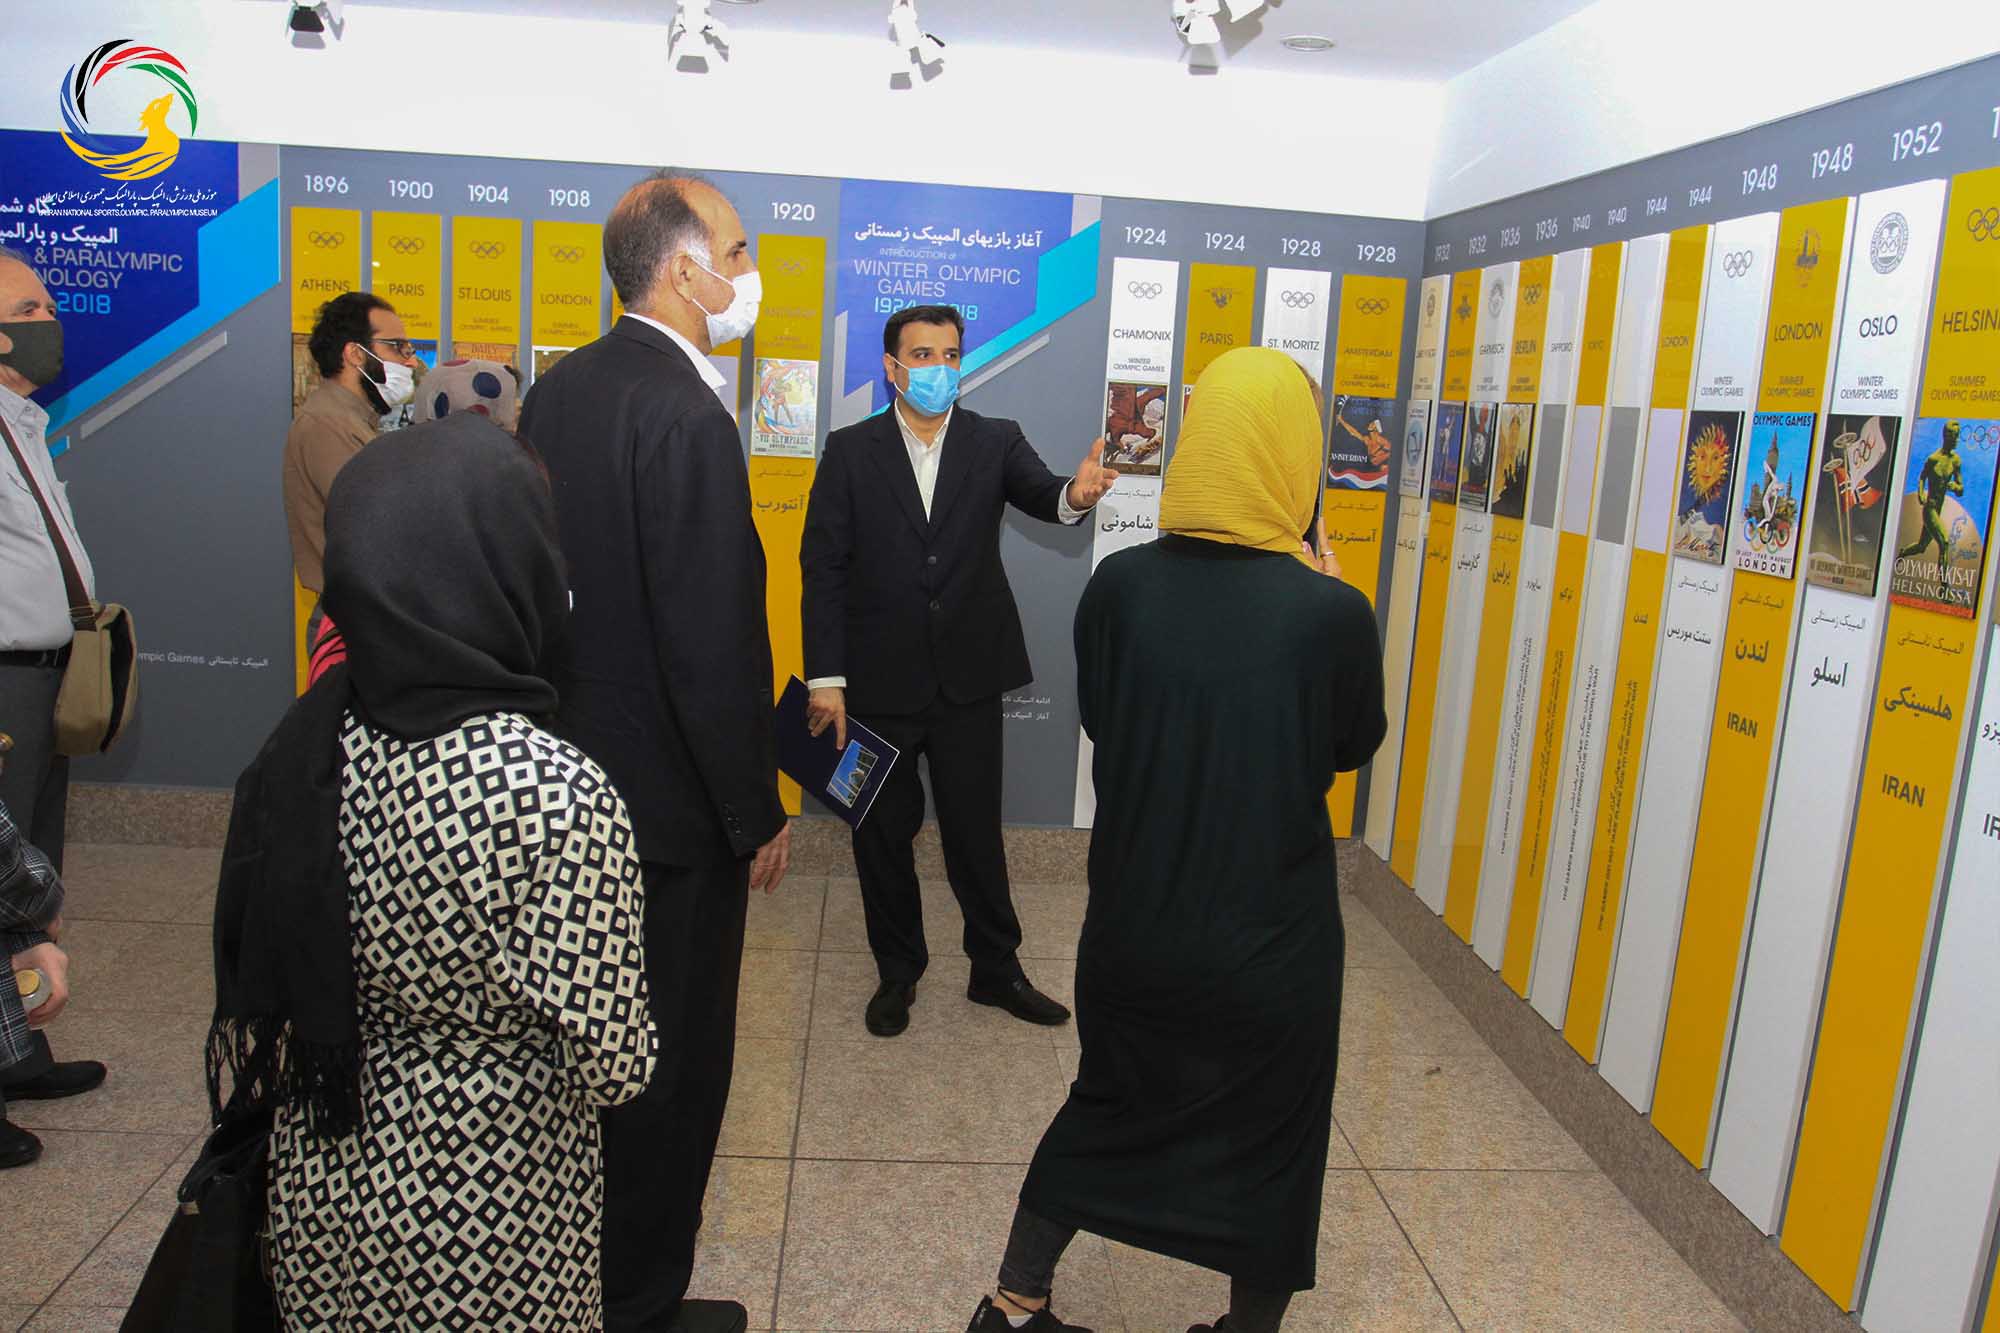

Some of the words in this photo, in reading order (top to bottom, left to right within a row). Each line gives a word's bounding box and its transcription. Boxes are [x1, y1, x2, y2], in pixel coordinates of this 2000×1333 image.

[1892, 121, 1942, 161] 1952
[1811, 143, 1854, 179] 1948
[304, 174, 350, 195] 1896
[388, 179, 434, 200] 1900
[1742, 164, 1778, 195] 1948
[467, 184, 510, 205] 1904
[548, 188, 591, 208] 1908
[1689, 185, 1713, 207] 1944
[771, 201, 816, 222] 1920
[1607, 206, 1628, 226] 1940
[1646, 196, 1668, 217] 1944
[854, 222, 909, 243] زمستانی
[1535, 218, 1558, 241] 1936
[1572, 214, 1591, 233] 1940
[50, 228, 59, 245] و
[61, 224, 118, 250] المپیک
[913, 226, 960, 247] المپیک
[962, 229, 1012, 248] بازیهای
[1014, 230, 1042, 248] آغاز
[1125, 226, 1168, 246] 1924
[1204, 232, 1246, 252] 1924
[1468, 235, 1487, 256] 1932
[1501, 226, 1521, 248] 1936
[879, 247, 947, 261] INTRODUCTION
[1281, 238, 1321, 257] 1928
[1356, 244, 1397, 263] 1928
[33, 247, 49, 265] &
[53, 247, 184, 273] PARALYMPIC
[854, 260, 929, 279] WINTER
[938, 264, 1022, 285] OLYMPIC
[299, 278, 351, 293] ATHENS
[388, 282, 425, 297] PARIS
[878, 279, 946, 298] GAMES
[56, 292, 112, 315] 2018
[539, 294, 592, 307] LONDON
[1859, 314, 1898, 338] OSLO
[1942, 307, 2000, 334] HELSIN
[1112, 328, 1171, 341] CHAMONIX
[1199, 332, 1234, 346] PARIS
[1773, 321, 1824, 343] LONDON
[1267, 338, 1281, 350] ST.
[1282, 339, 1320, 351] MORITZ
[1857, 375, 1884, 387] WINTER
[1949, 375, 1986, 387] SUMMER
[1840, 388, 1869, 400] OLYMPIC
[1870, 388, 1898, 400] GAMES
[1930, 388, 1968, 401] OLYMPIC
[1969, 389, 2000, 401] GAMES
[1753, 415, 1784, 427] OLYMPIC
[1785, 415, 1811, 427] GAMES
[1101, 514, 1154, 533] شامونی
[1738, 557, 1786, 574] LONDON
[1894, 557, 1977, 588] OLYMPIAKISAT
[1891, 577, 1971, 605] HELSINGISSA
[1810, 608, 1840, 630] زمستانی
[1840, 613, 1867, 631] المپیک
[1666, 625, 1693, 643] موریس
[1692, 629, 1712, 645] سنت
[167, 651, 204, 664] Games
[1735, 636, 1769, 663] لندن
[1811, 656, 1848, 688] اسلو
[1883, 686, 1953, 721] هلسینکی
[1727, 711, 1758, 739] IRAN
[1882, 773, 1926, 809] IRAN
